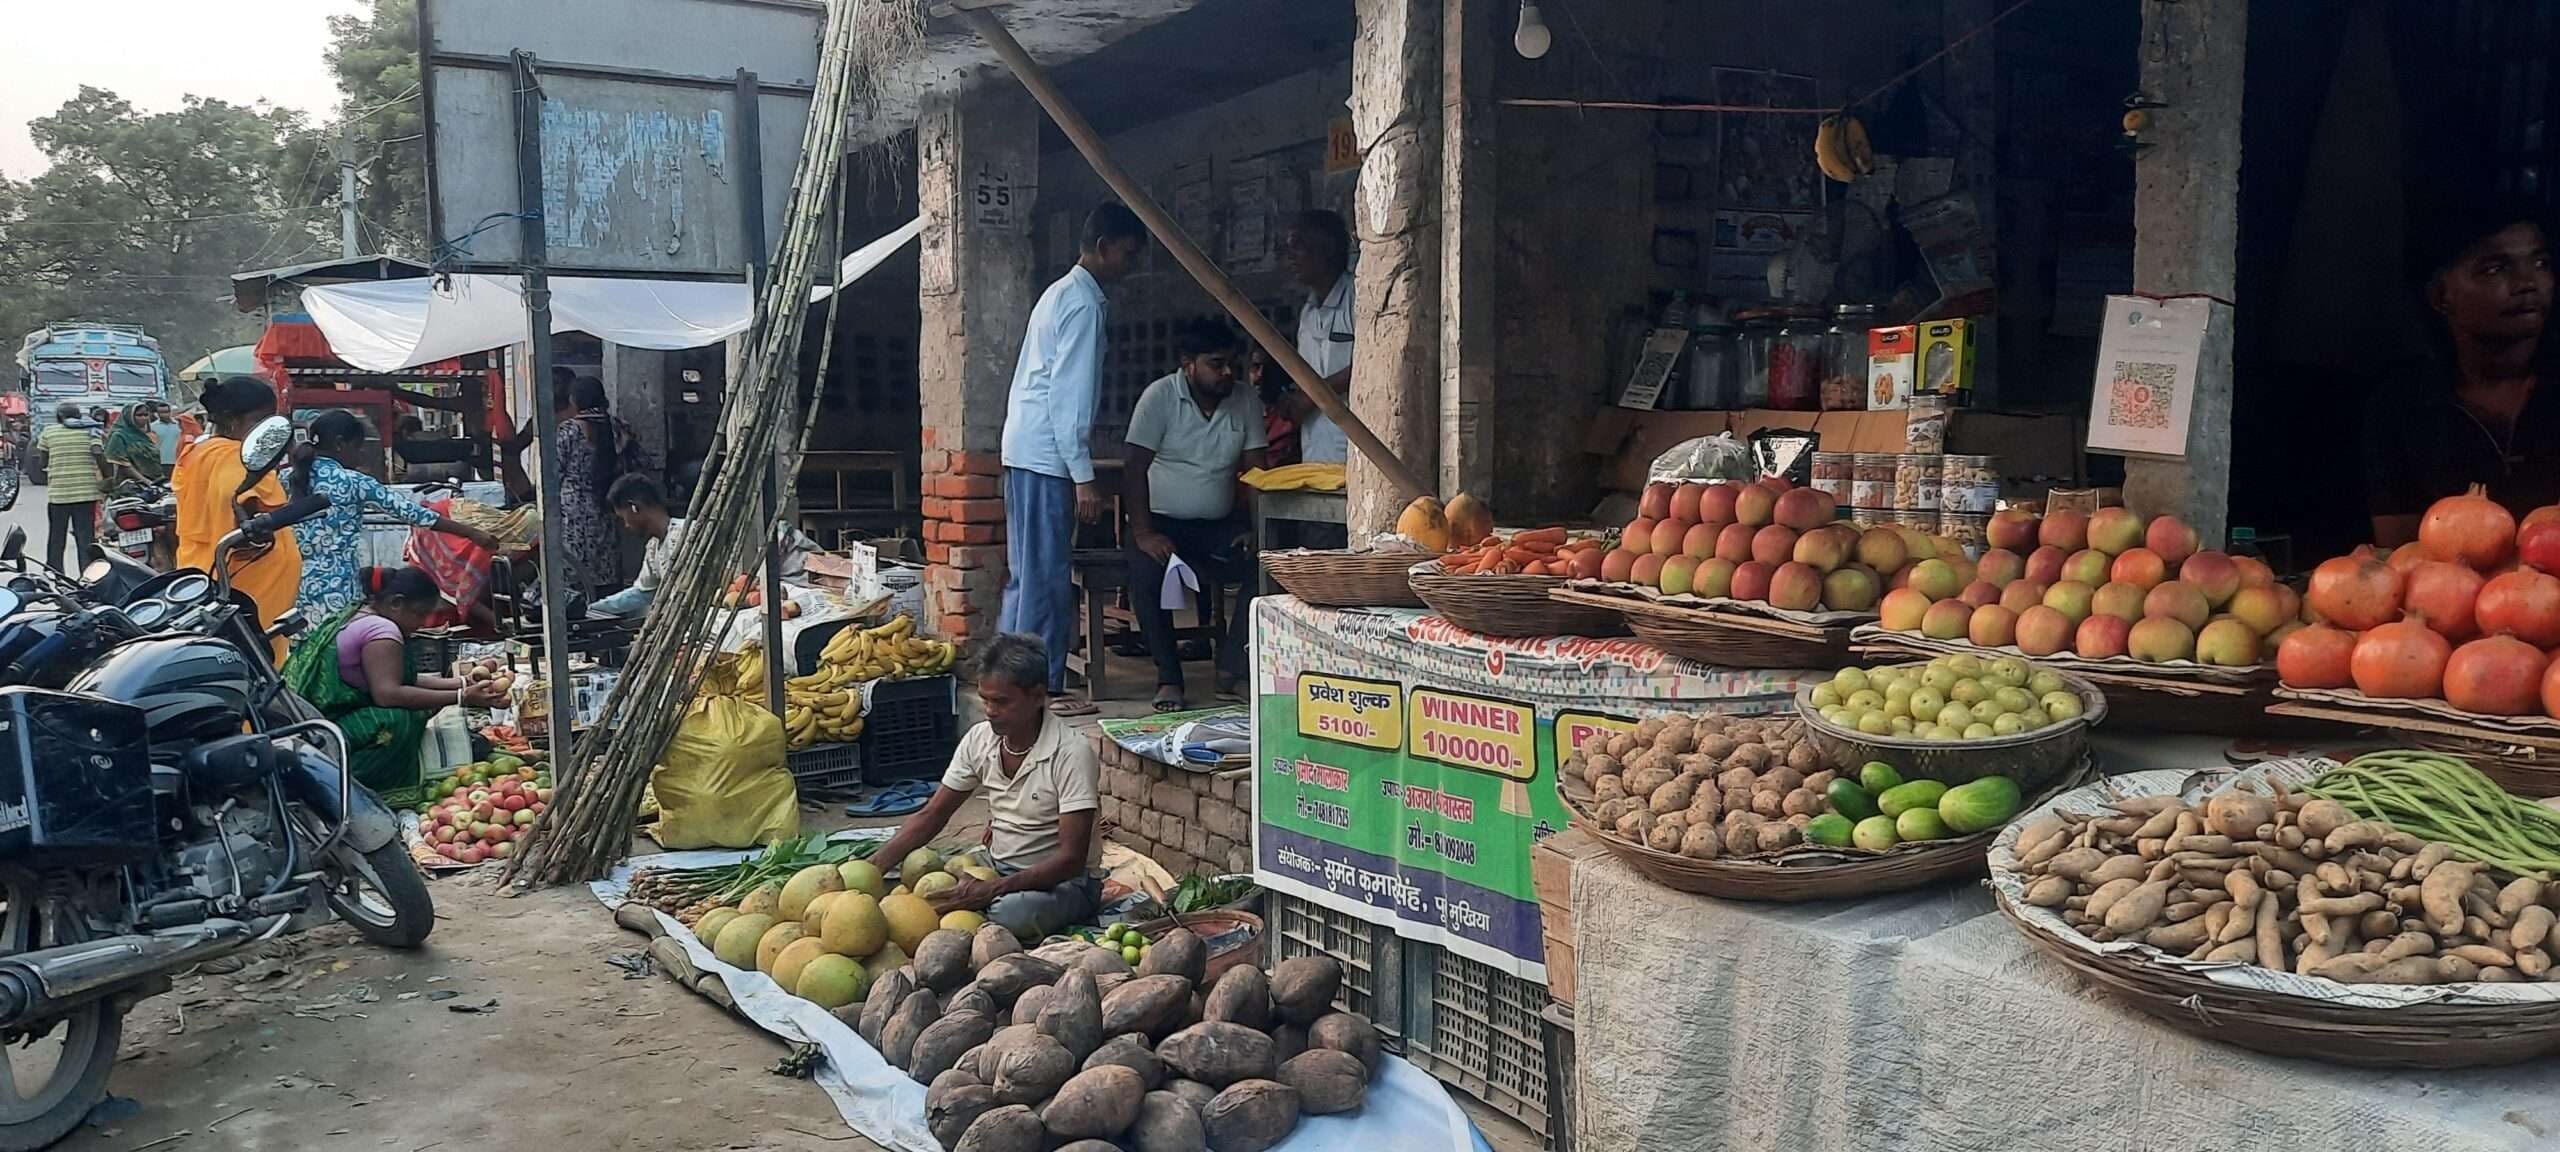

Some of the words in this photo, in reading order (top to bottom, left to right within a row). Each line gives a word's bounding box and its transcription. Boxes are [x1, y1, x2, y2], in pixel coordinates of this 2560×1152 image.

[978, 184, 1010, 206] 55
[1308, 681, 1344, 703] प्रवेश
[1348, 690, 1392, 714] शुल्क
[1319, 715, 1377, 737] 5100/-
[1421, 695, 1521, 735] WINNER
[1404, 785, 1433, 812] अजय
[1324, 857, 1356, 892] सुमंत
[1448, 900, 1491, 933] मुखिया
